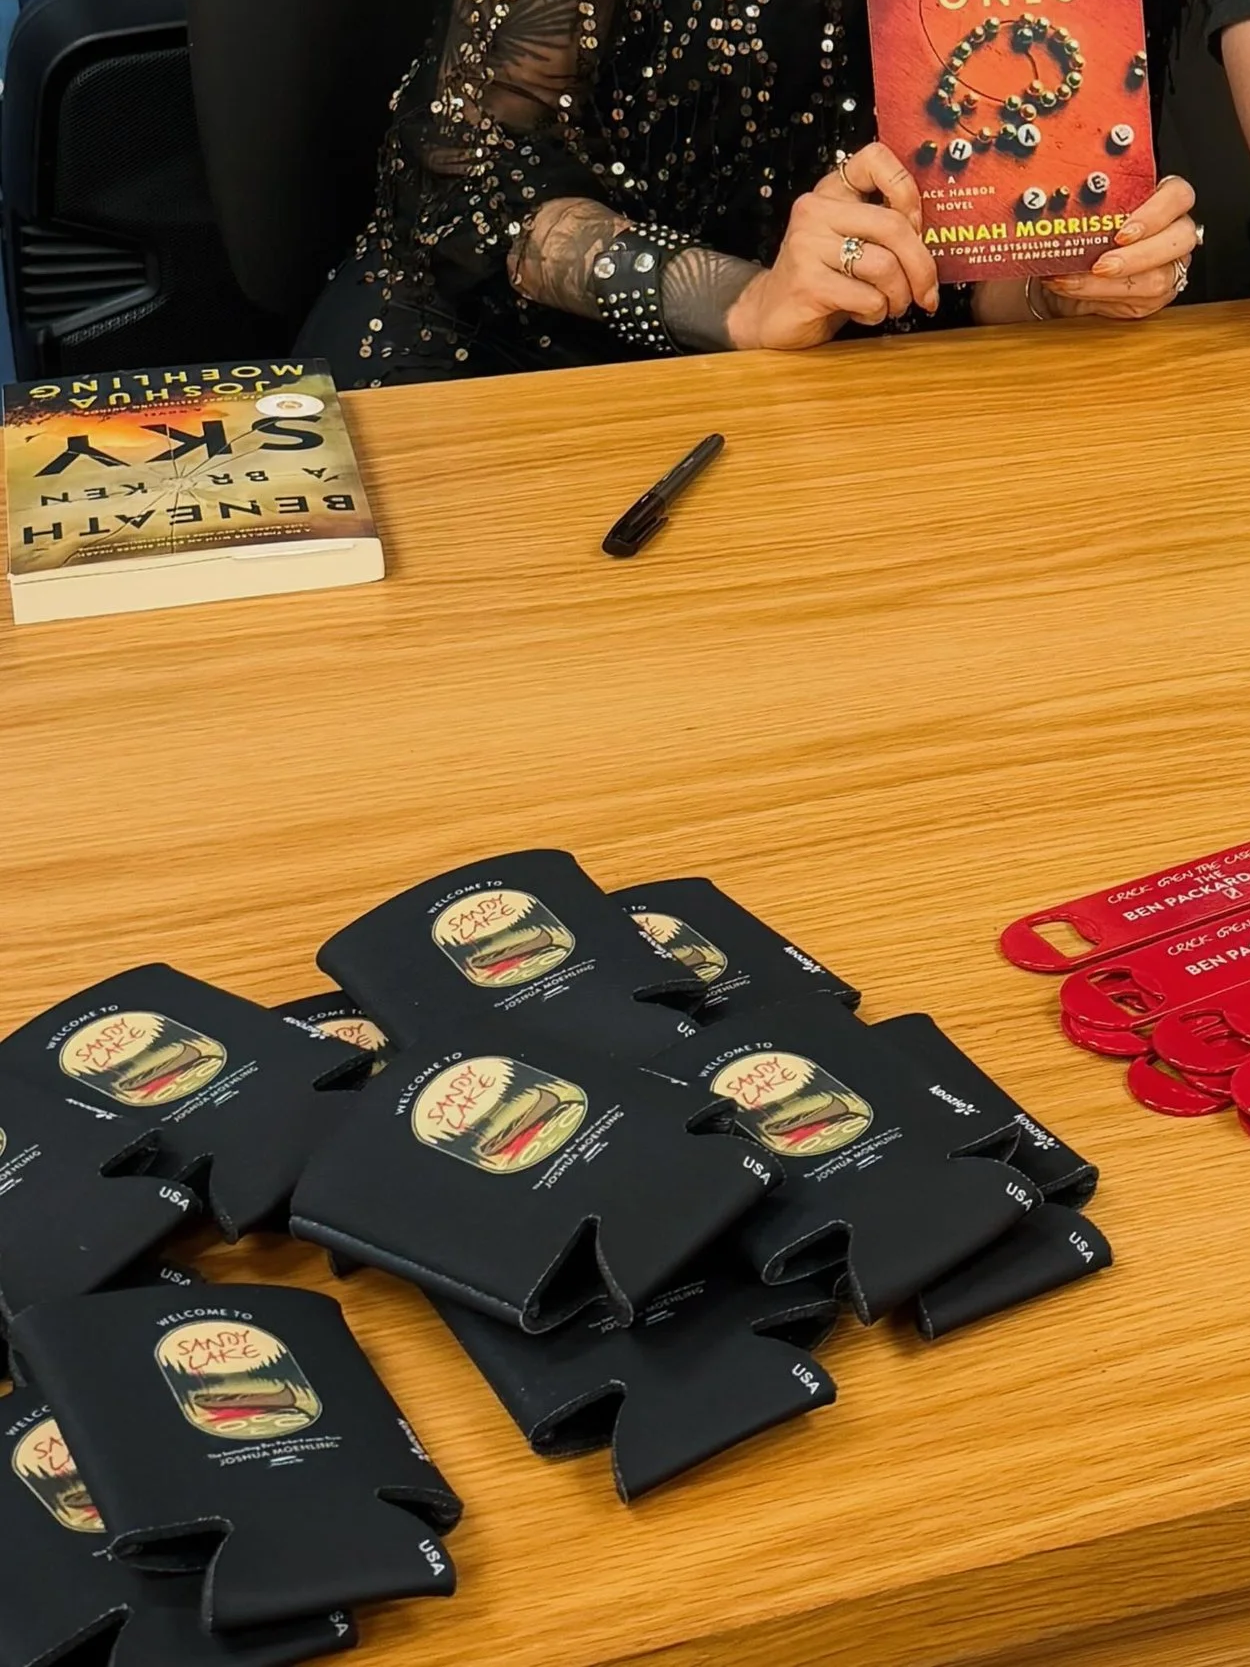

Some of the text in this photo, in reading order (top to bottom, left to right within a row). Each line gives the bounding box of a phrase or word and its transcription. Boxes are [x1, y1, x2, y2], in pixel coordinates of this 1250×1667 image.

[948, 175, 956, 185] A
[949, 185, 996, 197] HARBOR
[936, 200, 974, 212] NOVEL
[923, 212, 1128, 245] ANNAH MORRISSE
[950, 245, 985, 256] TODAY
[989, 240, 1060, 253] BESTSELLING
[1065, 236, 1109, 248] AUTHOR
[968, 247, 1086, 264] HELLO, TRANSCRIBER
[29, 364, 304, 399] MOEHLING
[70, 381, 271, 410] JOSHUA
[34, 415, 325, 477] SKY
[23, 494, 356, 544] BENEATH
[1108, 884, 1150, 905] CRACK
[1157, 867, 1194, 888] OPEN
[1198, 857, 1222, 879] THE
[1194, 866, 1226, 884] THE
[427, 883, 481, 914] WELCOME
[1122, 897, 1164, 922] BEN
[448, 894, 503, 931] SANDY
[459, 904, 517, 940] LAKE
[929, 1084, 966, 1109] koozie
[742, 1155, 772, 1186] USA
[159, 1185, 191, 1212] USA
[1068, 1231, 1094, 1263] USA
[156, 1308, 253, 1327] WELCOME TO
[177, 1330, 250, 1356] SANDY
[189, 1345, 260, 1370] LAKE
[219, 1450, 270, 1467] JOSHUA
[419, 1539, 445, 1576] USA
